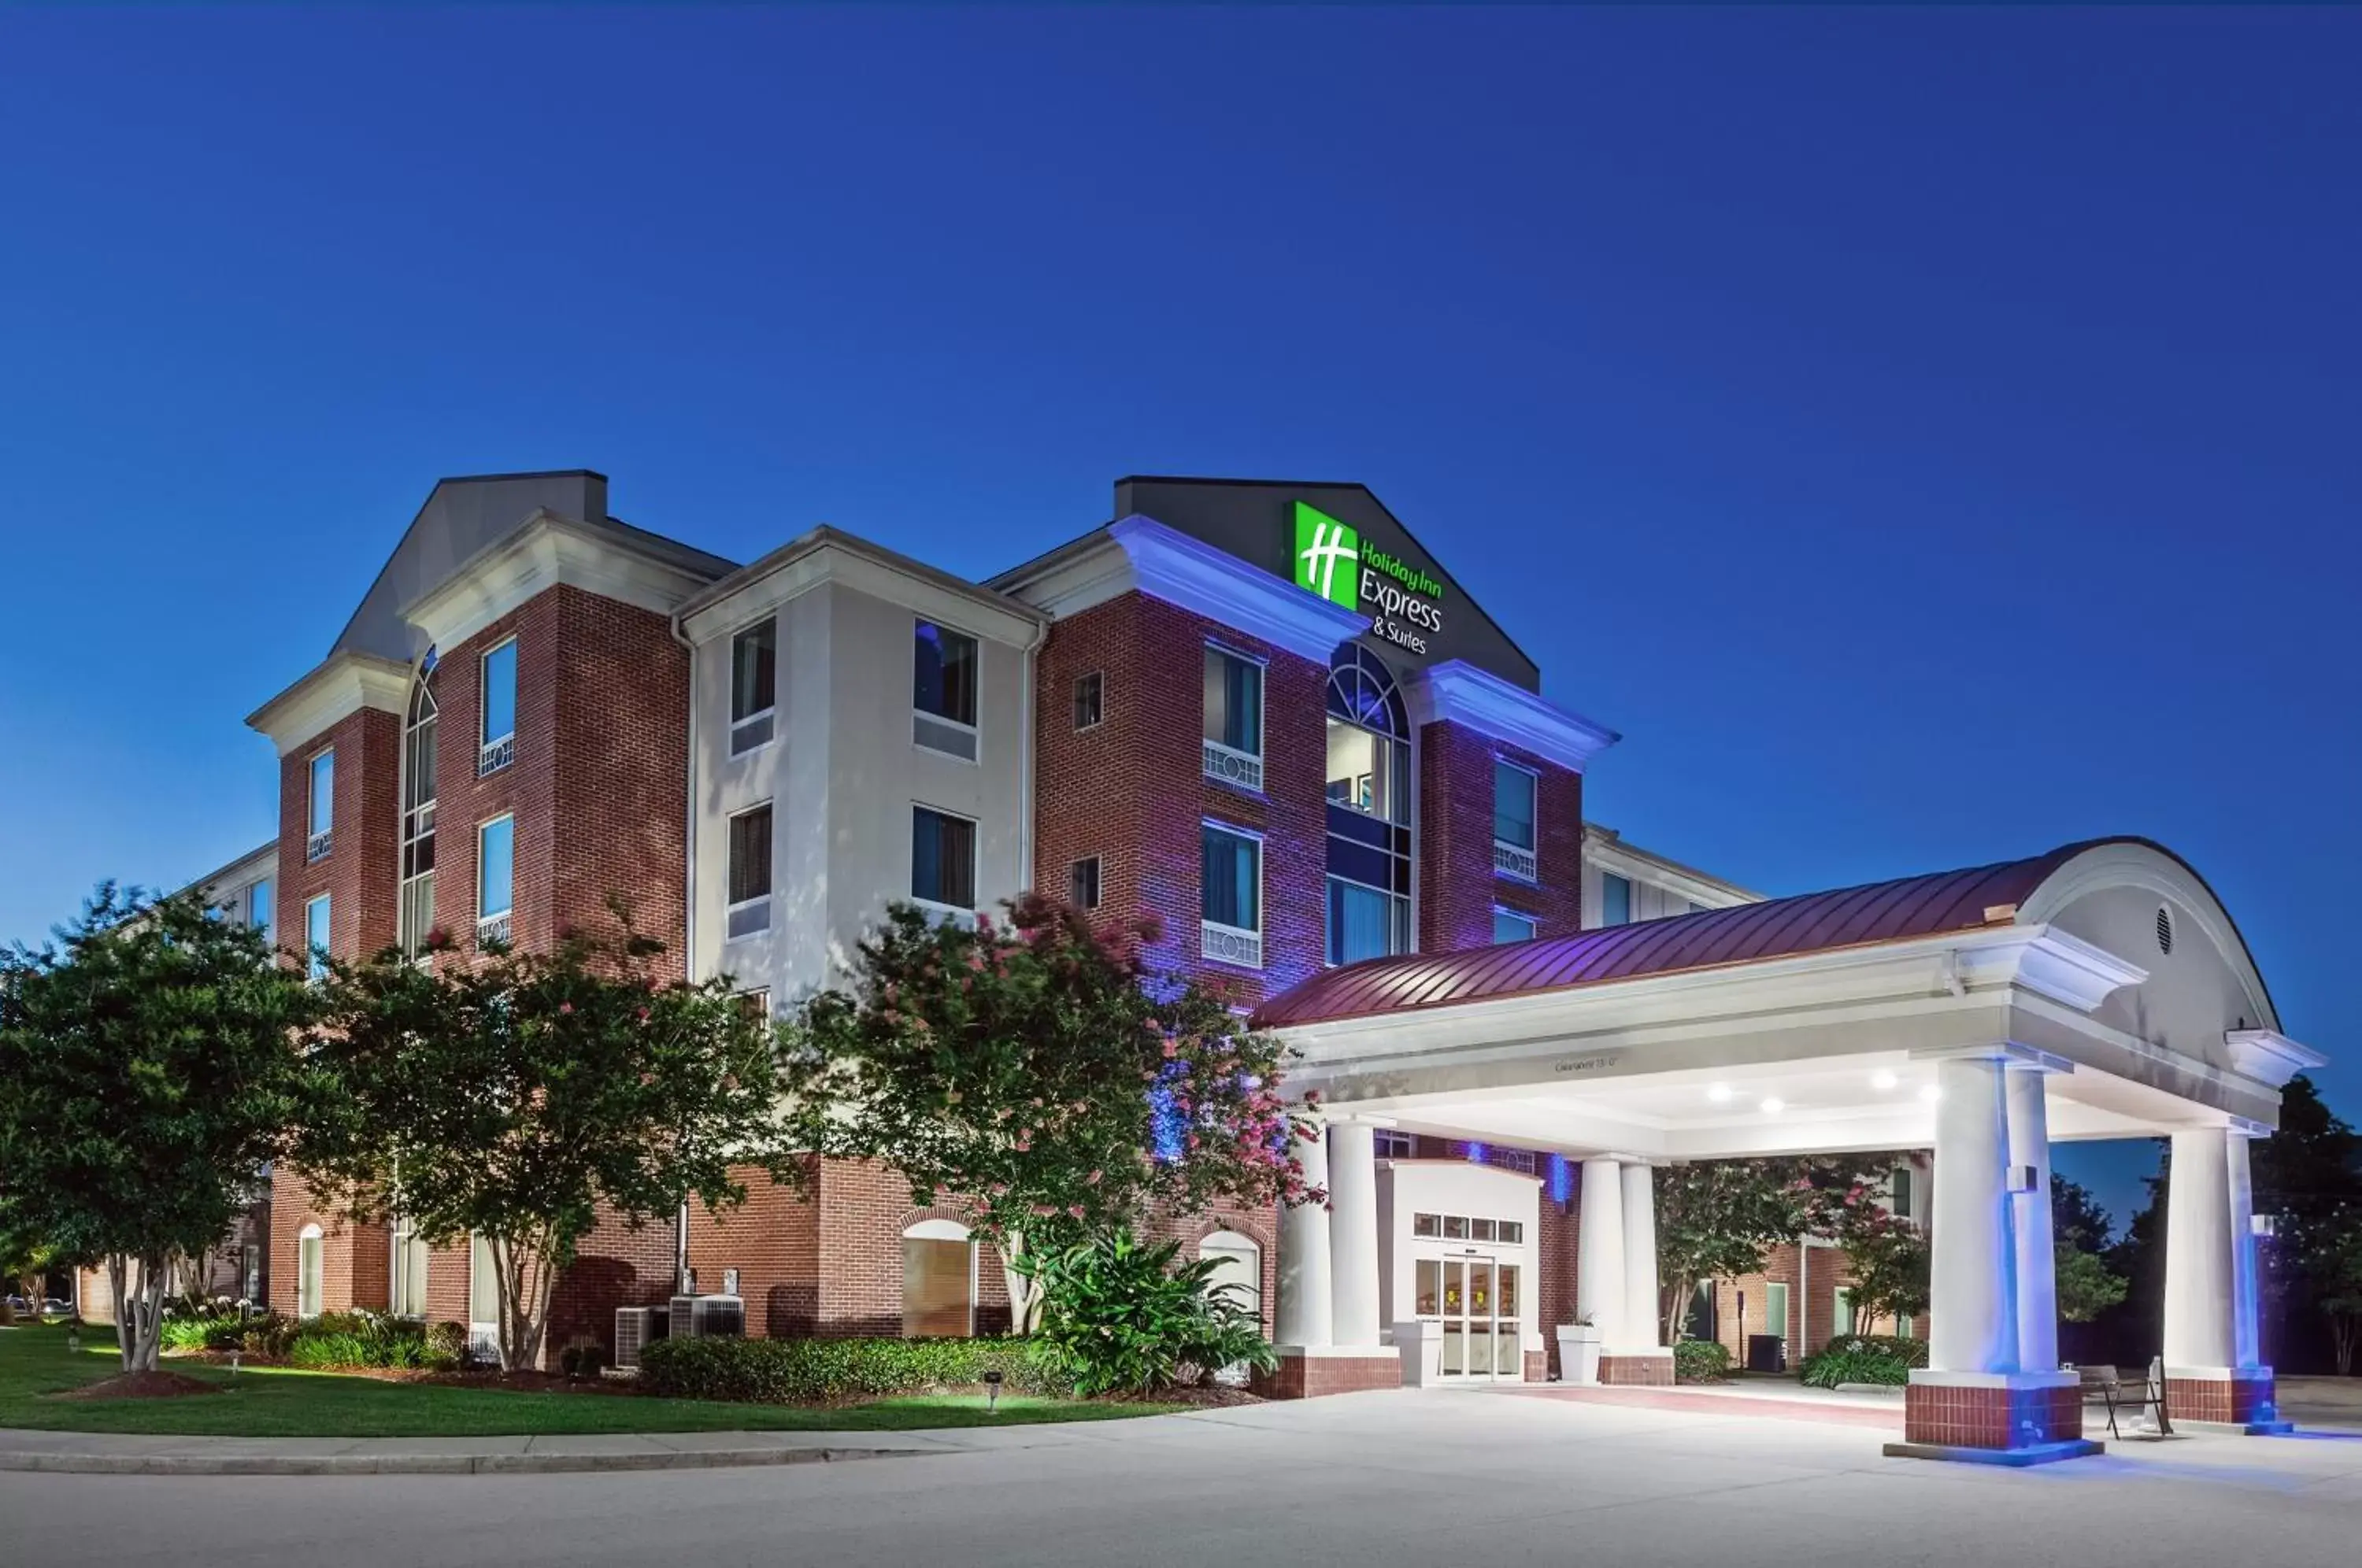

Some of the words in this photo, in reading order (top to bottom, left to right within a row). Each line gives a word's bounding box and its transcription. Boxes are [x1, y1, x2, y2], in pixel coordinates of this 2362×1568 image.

[1361, 539, 1419, 591] Holiday
[1419, 569, 1442, 598] Inn
[1360, 568, 1441, 632] Express
[1373, 616, 1385, 636] &
[1386, 621, 1426, 654] Suites
